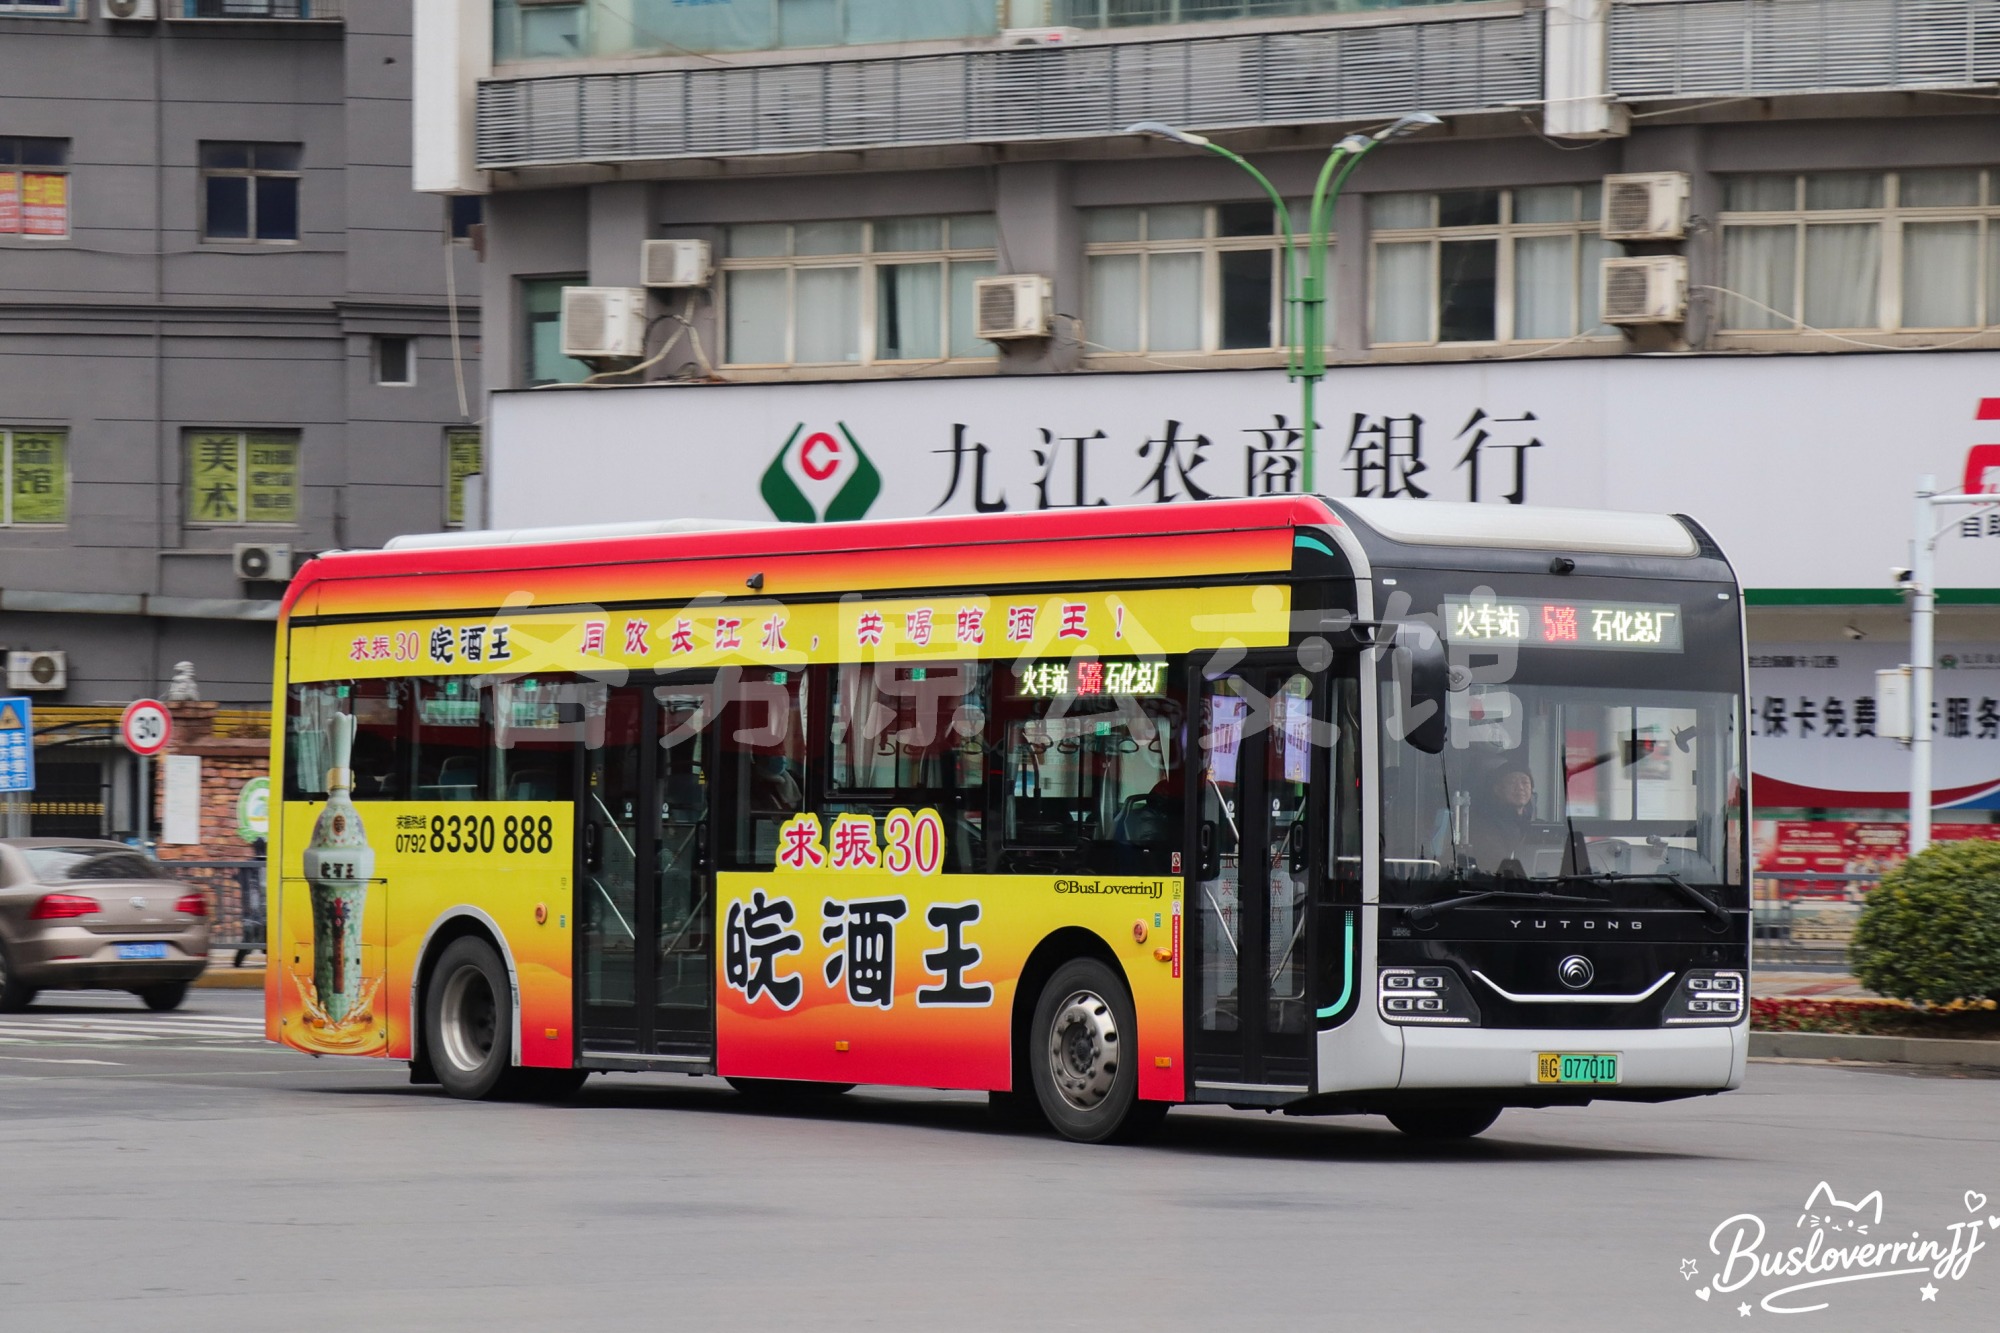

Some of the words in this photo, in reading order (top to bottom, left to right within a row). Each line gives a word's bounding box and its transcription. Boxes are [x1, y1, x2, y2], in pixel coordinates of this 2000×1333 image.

[199, 437, 237, 517] 美术
[926, 407, 1546, 513] 九江农商银行
[1456, 604, 1520, 638] 火车站
[1592, 609, 1676, 642] 石化总厂
[430, 625, 511, 663] 皖酒王
[1020, 663, 1070, 695] 火车站
[1105, 661, 1170, 694] 石化总厂
[137, 716, 162, 739] 30
[396, 834, 426, 853] 0792
[430, 815, 495, 853] 8330
[503, 815, 553, 853] 888
[781, 817, 939, 872] 求振30
[1510, 920, 1642, 929] YUTONG
[726, 891, 992, 1008] 皖酒王
